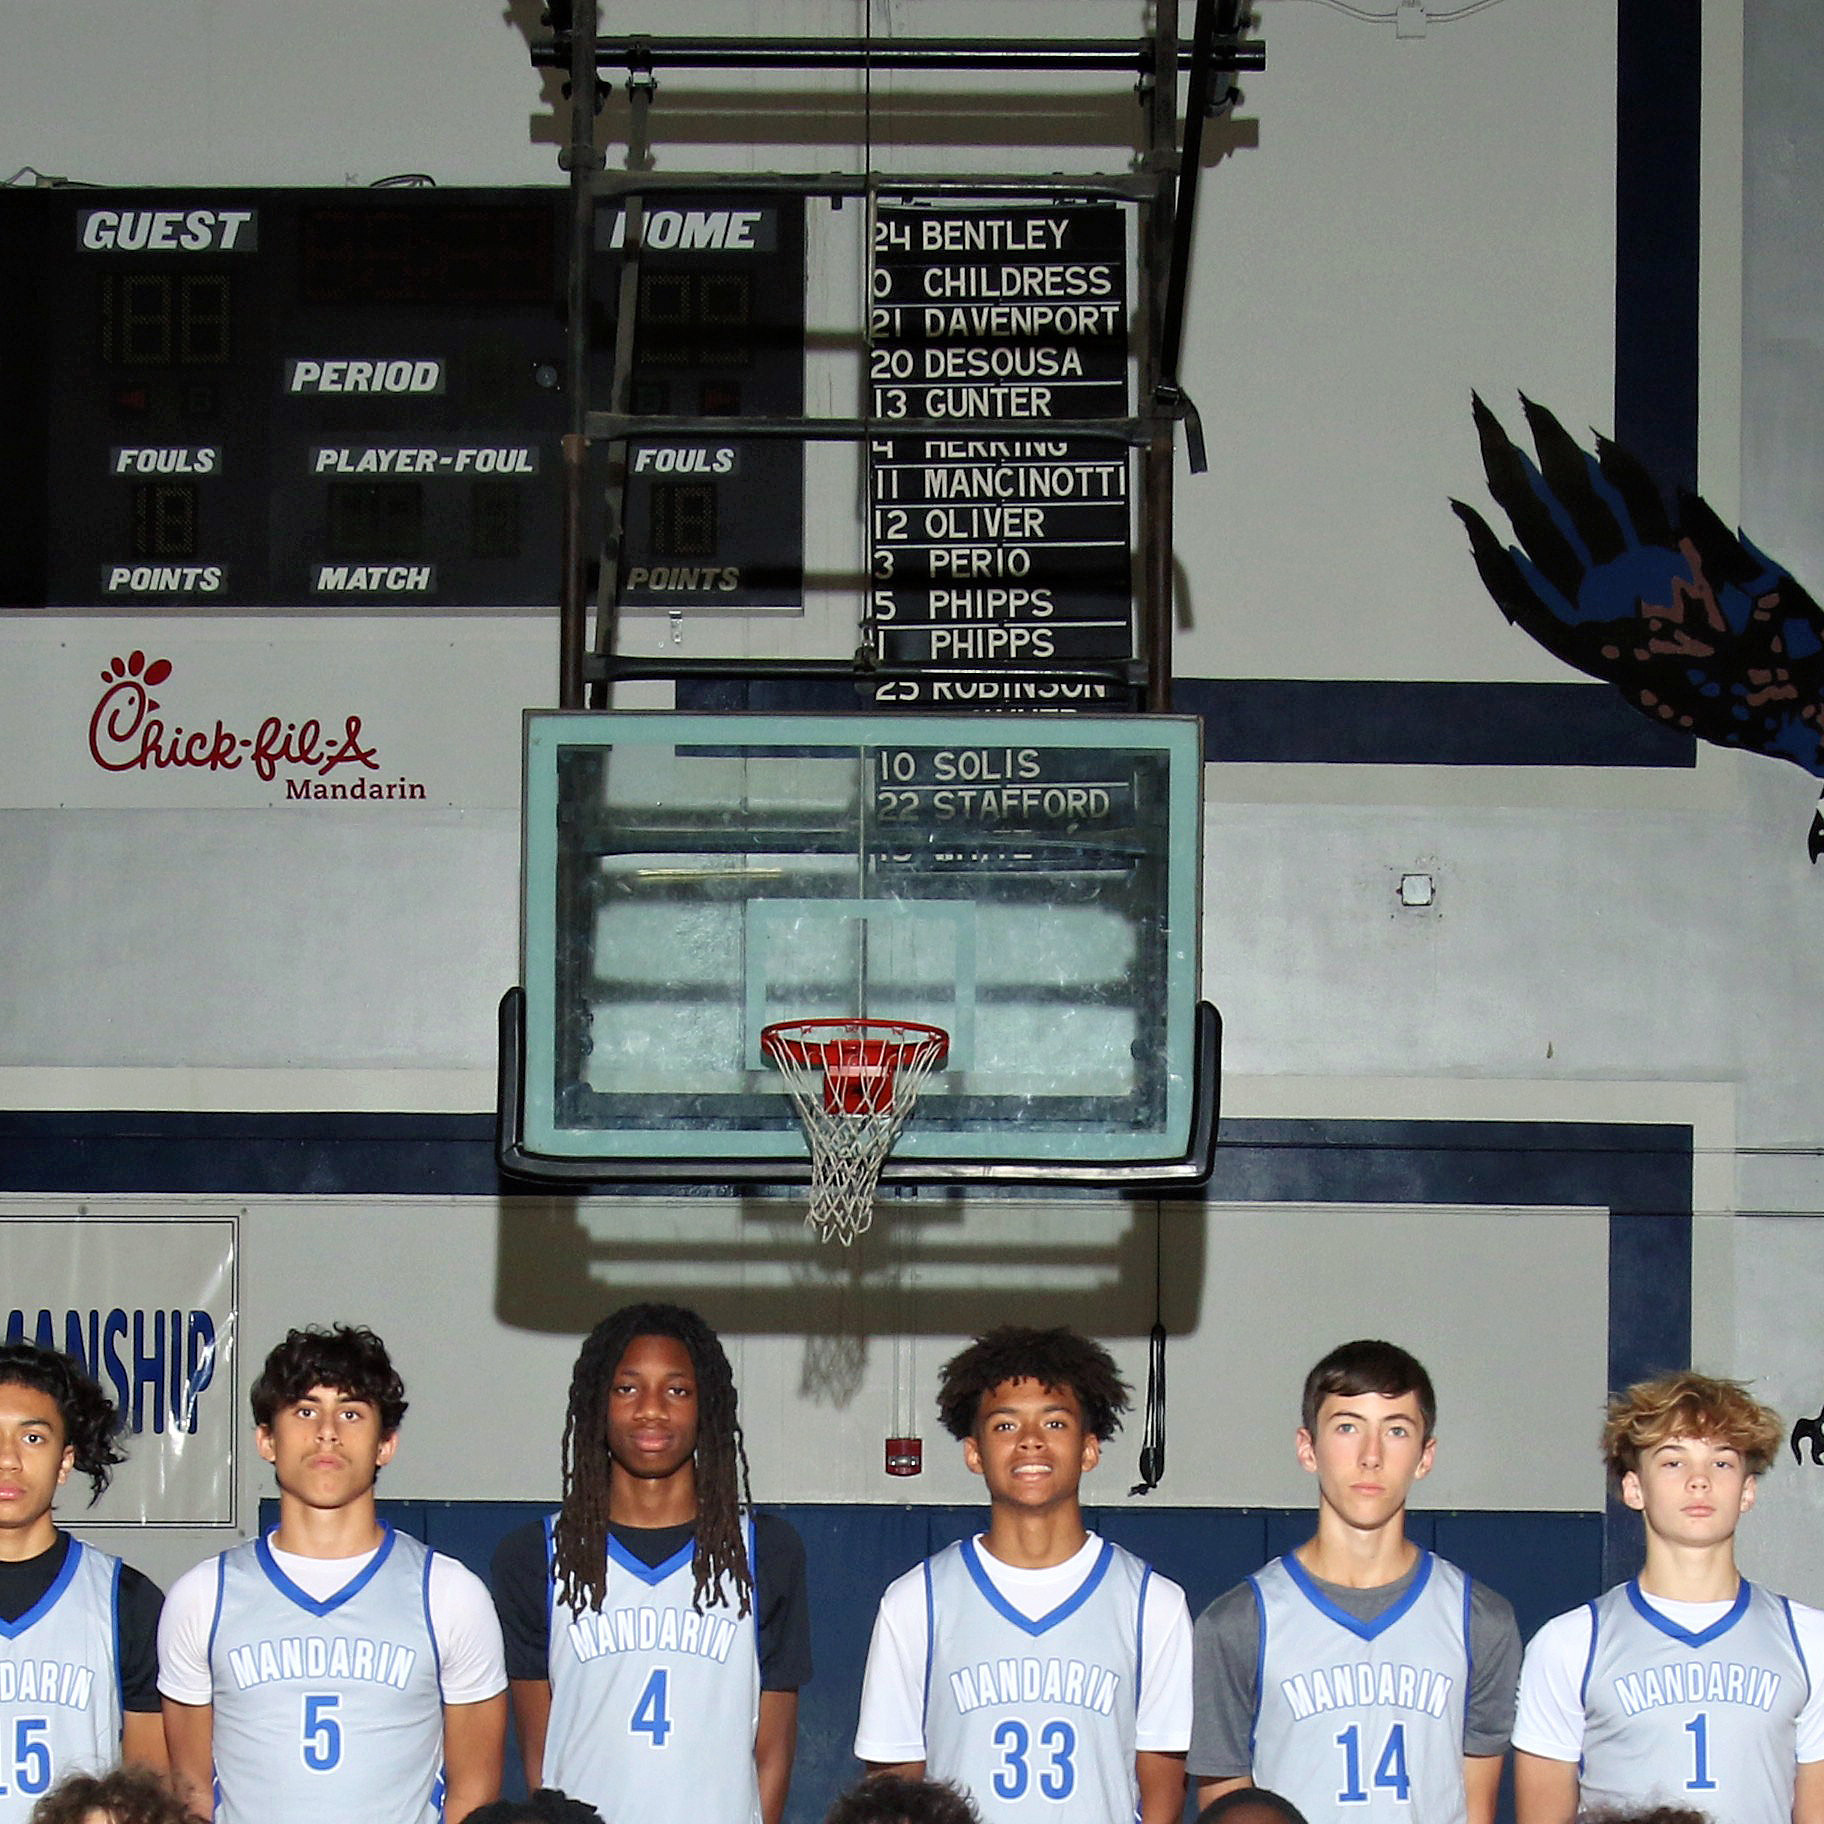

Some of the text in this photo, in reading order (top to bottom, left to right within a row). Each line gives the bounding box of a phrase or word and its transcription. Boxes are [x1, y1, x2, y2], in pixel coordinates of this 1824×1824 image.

[82, 210, 251, 250] GUEST
[875, 219, 1069, 251] 24 BENTLEY
[923, 266, 1112, 297] CHILDRESS
[872, 306, 1120, 338] 21 DAVENPORT
[291, 361, 440, 392] PERIOD
[871, 347, 1083, 379] 20 DESOUSA
[876, 387, 1052, 419] 13 GUNTER
[117, 448, 215, 473] FOULS
[315, 448, 534, 473] PLAYER-FOUL
[635, 448, 734, 473] FOULS
[877, 466, 1125, 499] 11 MANCINOTTI
[876, 508, 1045, 540] 12 OLIVER
[109, 567, 221, 592] POINTS
[317, 566, 431, 591] MATCH
[627, 567, 740, 592] POINTS
[873, 548, 1031, 580] 3 PERIO
[875, 588, 1054, 621] 5 PHIPPS
[878, 628, 1055, 660] 1 PHIPPS
[89, 672, 380, 782] Chick-fil-A
[881, 749, 1041, 781] 10 SOLIS
[285, 777, 427, 801] Mandarin
[877, 788, 1111, 821] 22 STAFFORD
[568, 1607, 737, 1664] MANDARIN
[228, 1637, 416, 1690] MANDARIN
[949, 1658, 1121, 1717] MANDARIN
[1280, 1662, 1453, 1721] MANDARIN
[1614, 1661, 1781, 1717] MANDARIN
[628, 1665, 673, 1749] 4
[300, 1692, 344, 1773] 5
[991, 1717, 1079, 1804] 33
[1333, 1719, 1413, 1804] 14
[1683, 1711, 1721, 1792] 1
